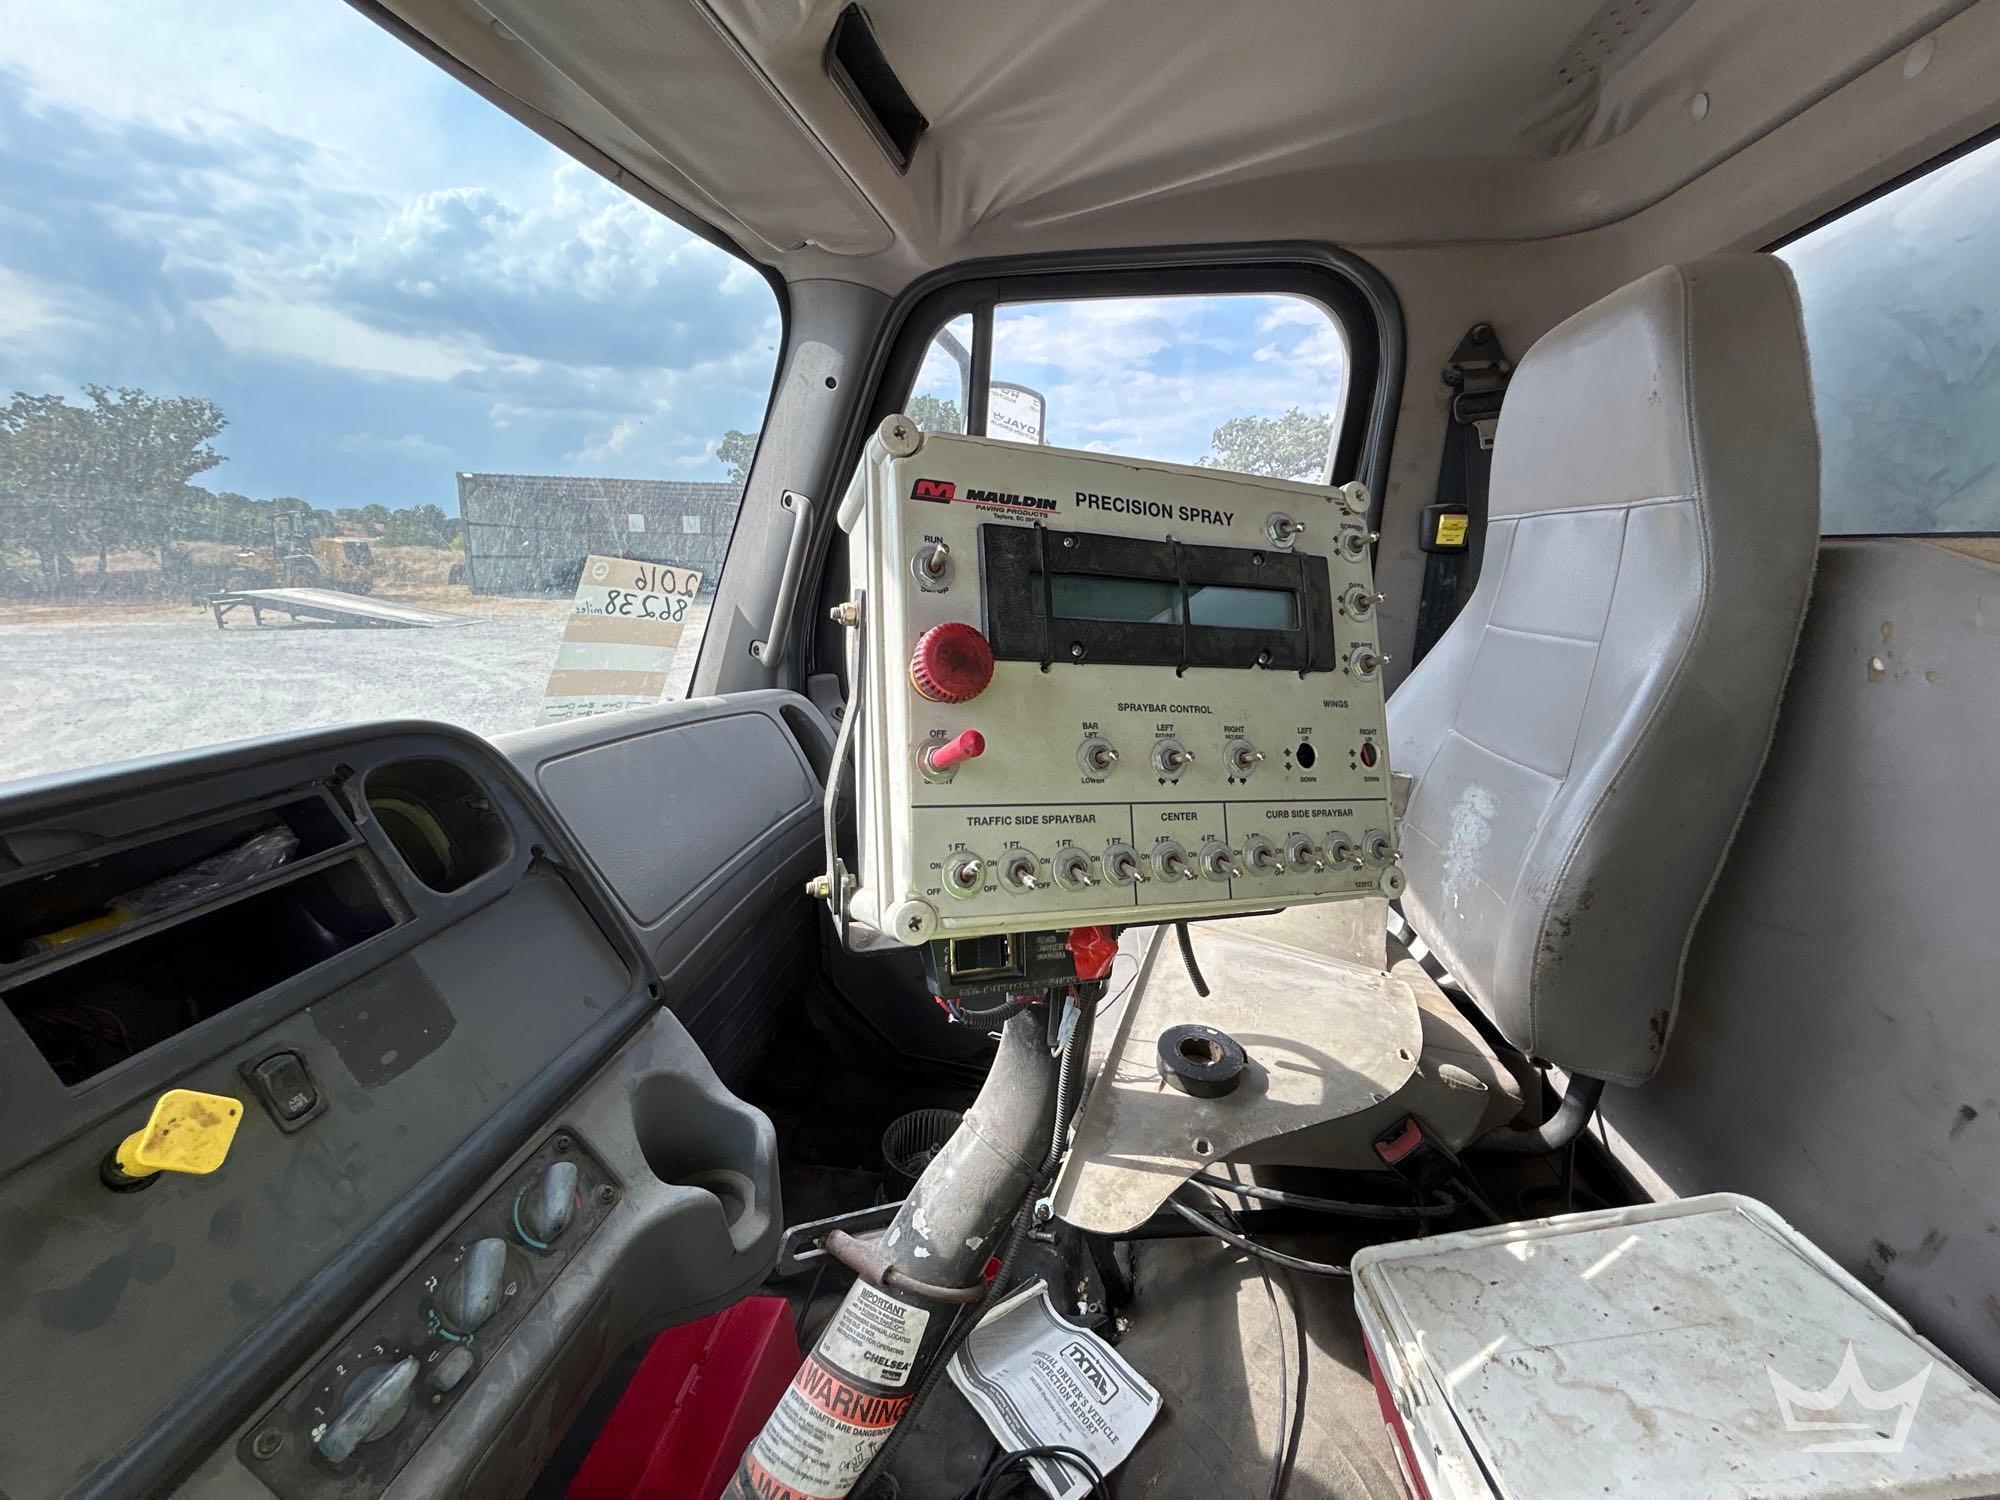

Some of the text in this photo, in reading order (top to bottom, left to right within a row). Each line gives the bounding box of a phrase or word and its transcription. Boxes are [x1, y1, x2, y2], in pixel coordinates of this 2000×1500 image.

[966, 489, 1057, 511] MAULDIN
[975, 504, 1048, 519] PAVING PRODUCTS
[1075, 491, 1234, 527] PRECISION SPRAY
[924, 535, 943, 544] RUN
[1117, 702, 1213, 715] SPRAYBAR CONTROL
[1323, 699, 1349, 709] WINGS
[1082, 722, 1099, 730] BAR
[1156, 723, 1174, 732] LEFT
[1224, 725, 1245, 734] RIGHT
[1297, 727, 1313, 735] LEFT
[929, 729, 948, 738] OFF
[1084, 731, 1098, 739] LIFT
[1359, 728, 1377, 736] RIGHT
[1161, 812, 1198, 822] CENTER
[1265, 808, 1354, 819] CURB SIDE SPRAYBAR
[966, 814, 1096, 826] TRAFFIC SIDE SPRAYBAR
[954, 843, 968, 851] FT.
[1009, 841, 1023, 849] FT.
[1040, 857, 1051, 865] ON
[1090, 855, 1101, 863] ON
[930, 862, 941, 870] ON
[984, 885, 998, 893] OFF
[1038, 881, 1051, 889] OFF
[926, 888, 941, 896] OFF
[860, 1287, 907, 1317] IMPORTANT
[869, 1321, 888, 1337] MANUAL
[888, 1331, 912, 1344] LOCATED
[373, 1345, 384, 1355] 3
[876, 1342, 904, 1356] OPERATING
[863, 1350, 909, 1371] CHELSEA
[336, 1365, 348, 1376] 2
[802, 1363, 911, 1425] WARNING
[1033, 1357, 1073, 1401] INSPECTION
[1069, 1400, 1099, 1436] REPORT
[314, 1406, 325, 1415] 1
[1056, 1366, 1089, 1407] DRIVER'S
[1088, 1405, 1120, 1445] VEHICLE
[809, 1406, 836, 1428] SHAFTS
[835, 1420, 852, 1434] ARE
